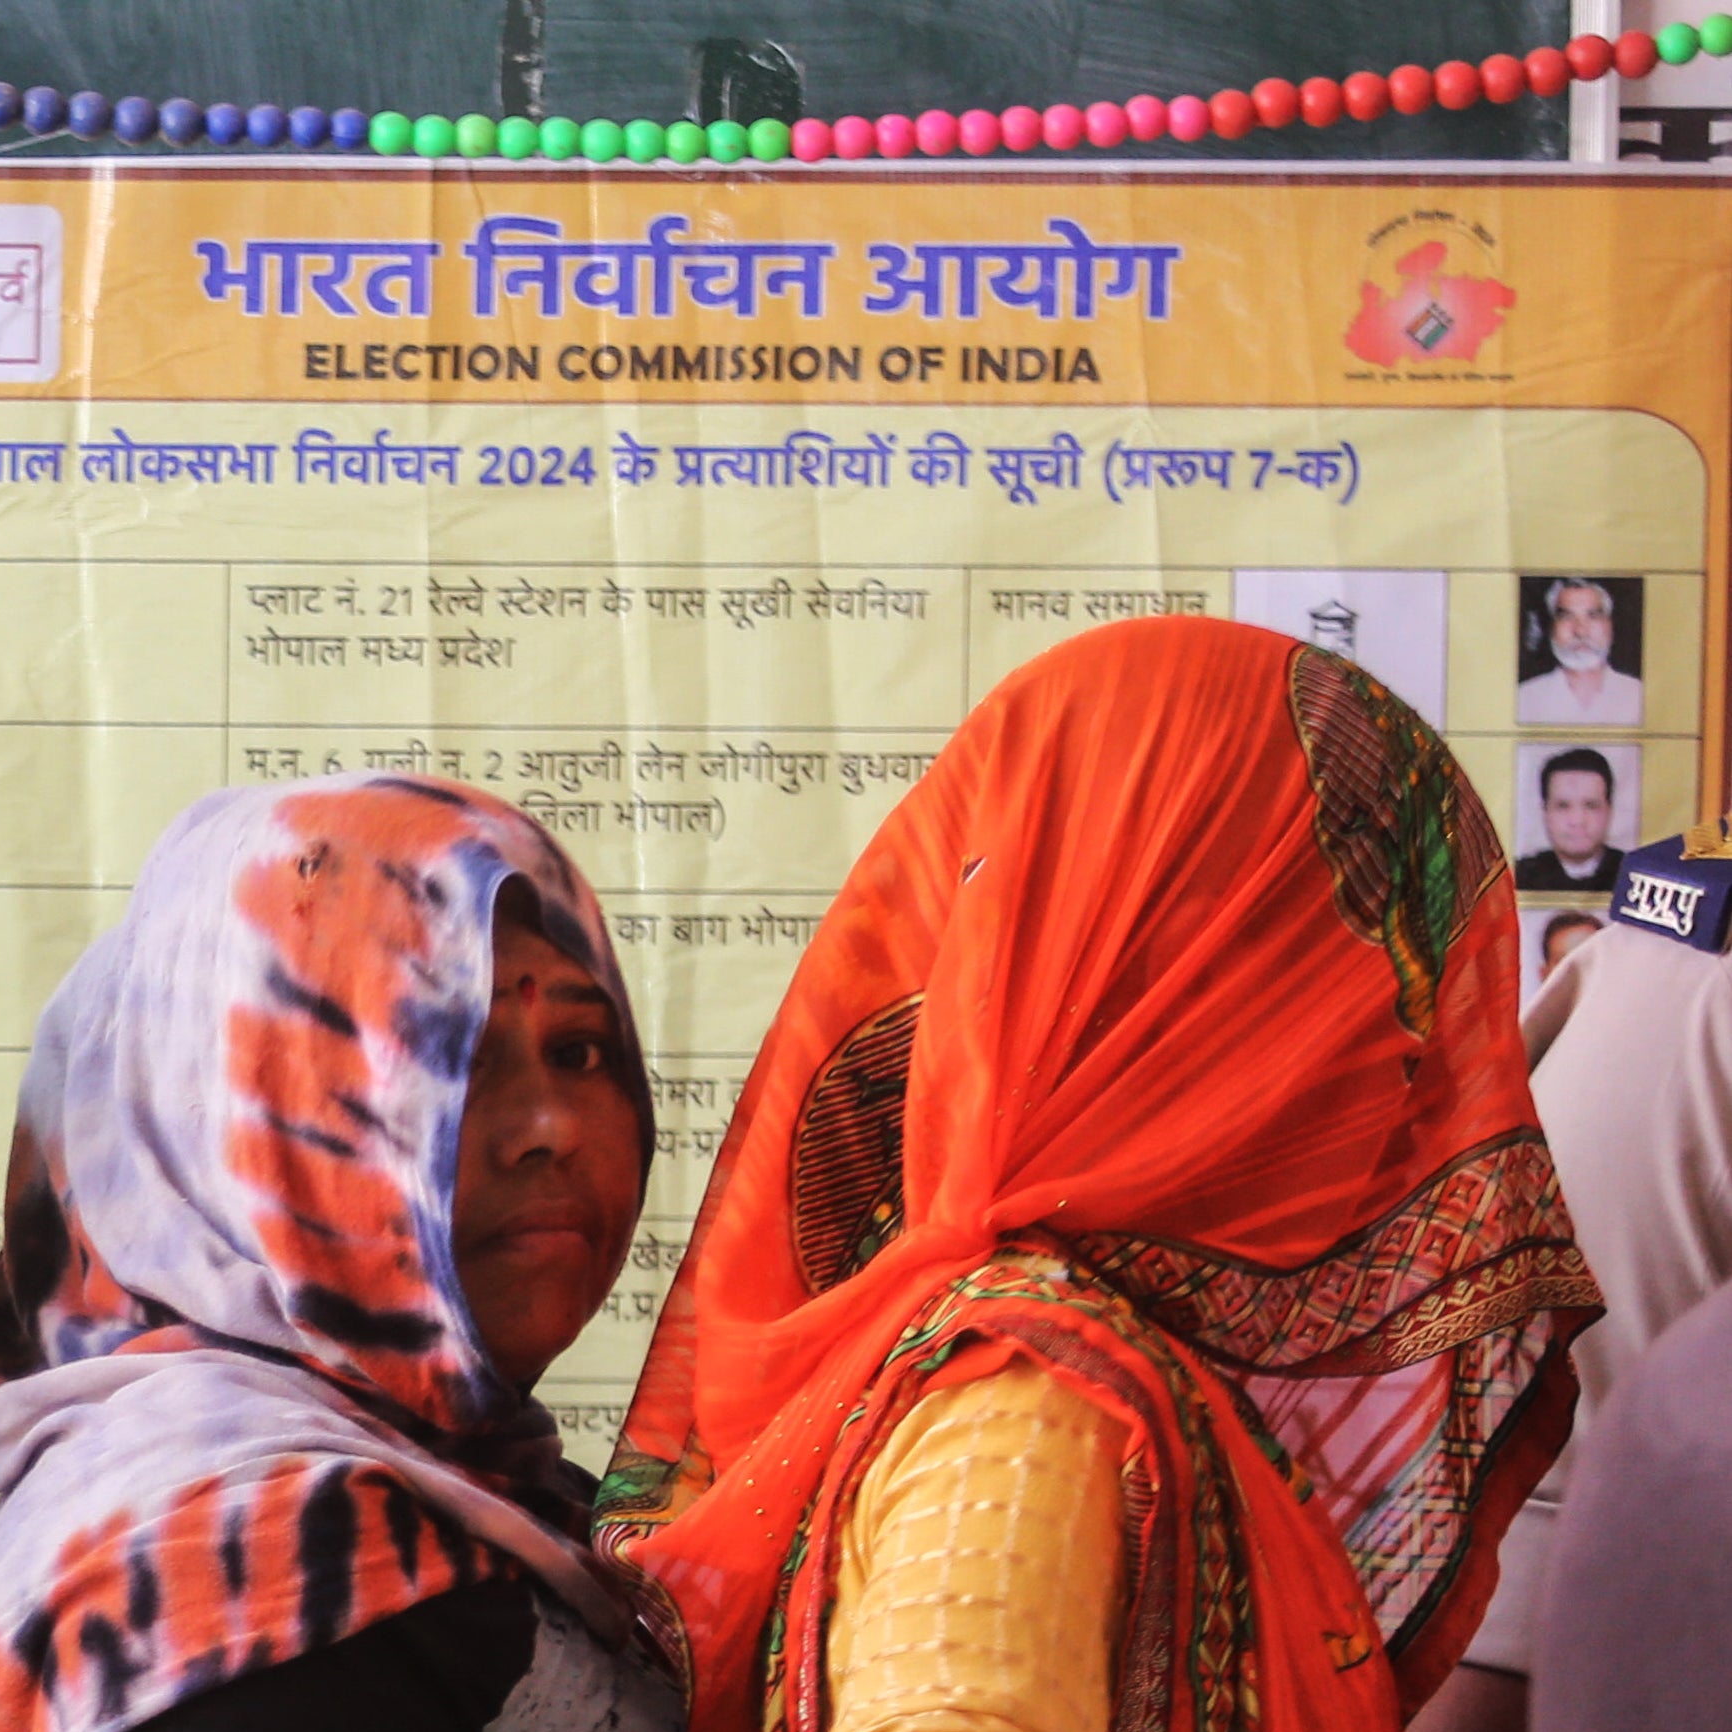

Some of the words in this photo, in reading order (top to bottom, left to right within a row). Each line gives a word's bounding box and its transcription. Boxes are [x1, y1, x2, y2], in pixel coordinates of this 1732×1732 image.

[197, 241, 439, 316] भारत
[465, 217, 834, 317] निर्वाचन
[865, 219, 1181, 320] आयोग
[305, 343, 538, 381] ELECTION
[558, 344, 861, 382] COMMISSION
[879, 346, 943, 381] OF
[960, 347, 1101, 384] INDIA
[80, 428, 278, 486] लोकसभा
[292, 429, 461, 487] निर्वाचन
[479, 444, 596, 487] 2024
[611, 431, 658, 488] के
[674, 431, 894, 488] प्रत्याशियों
[908, 433, 969, 489] की
[986, 432, 1083, 503] सूची
[1104, 439, 1232, 504] (प्ररूप
[1251, 440, 1360, 503] 7-क)
[334, 576, 365, 617] नं.
[379, 587, 414, 617] 21
[497, 577, 589, 620] स्टेशन
[594, 576, 632, 620] के
[644, 586, 708, 620] पास
[719, 577, 794, 630] सूखी
[990, 589, 1073, 621] मानव
[246, 627, 347, 668] भोपाल
[361, 636, 428, 668] मध्य
[439, 628, 516, 669] प्रदेश
[486, 751, 503, 780] 2
[634, 741, 688, 781] लेन
[697, 741, 829, 794] जोगीपुरा
[614, 792, 726, 842] भोपाल)
[739, 904, 822, 946] भोपा
